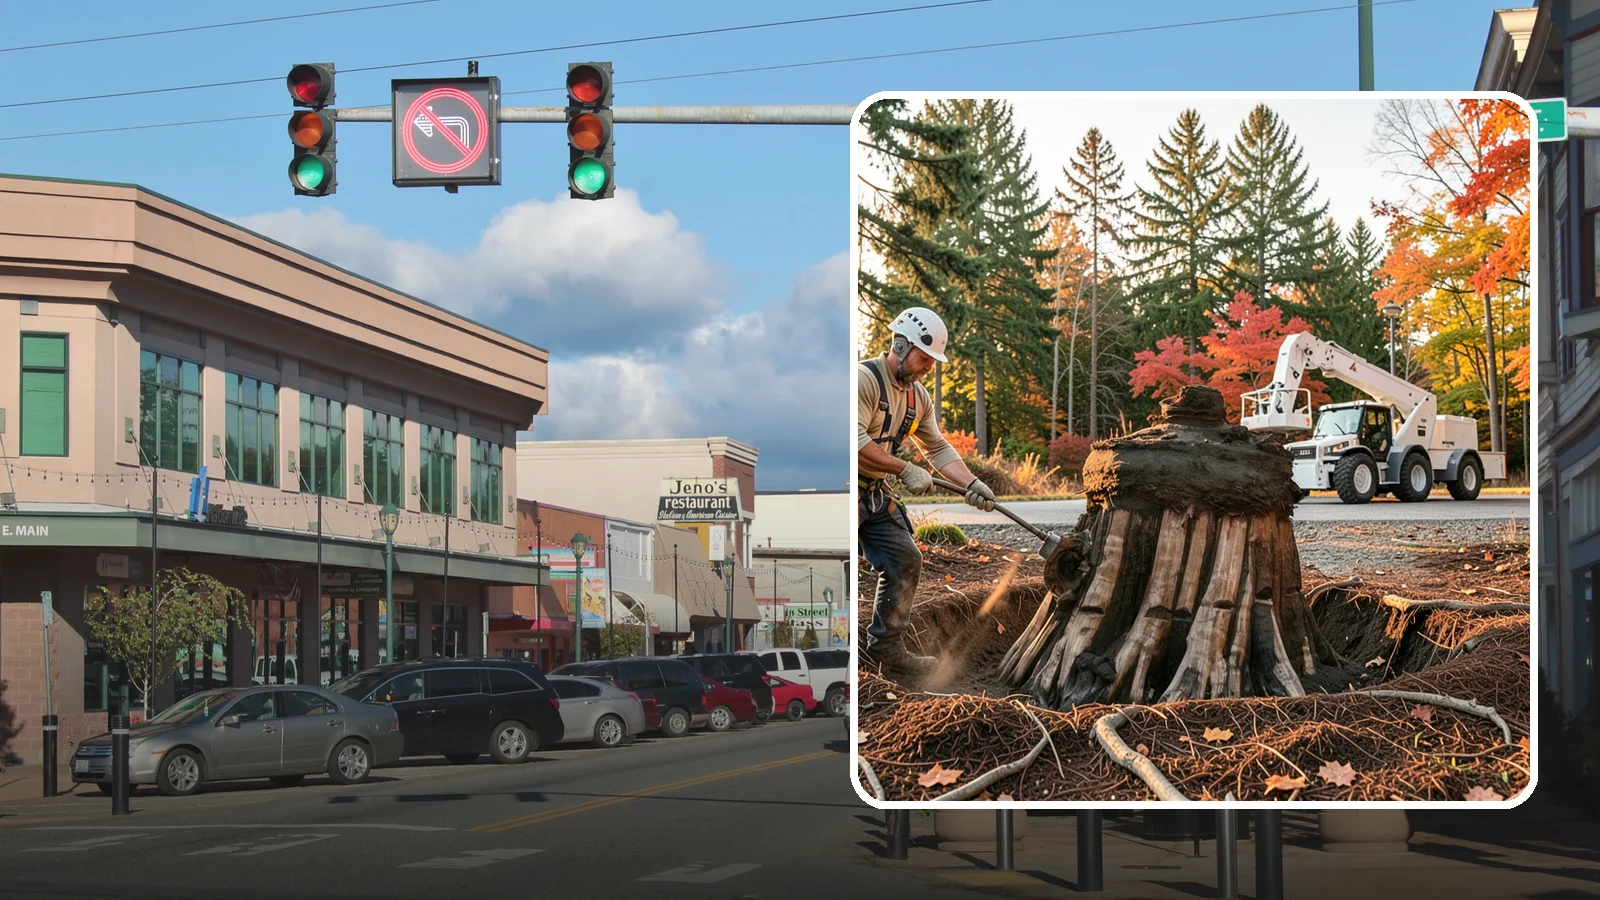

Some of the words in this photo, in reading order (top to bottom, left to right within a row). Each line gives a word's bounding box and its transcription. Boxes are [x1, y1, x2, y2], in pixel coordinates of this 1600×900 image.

[670, 480, 727, 494] Jeno's
[665, 497, 731, 509] restaurant
[658, 510, 682, 520] Italian
[686, 510, 714, 520] American
[715, 510, 737, 519] Cuisine
[2, 525, 13, 536] E.
[15, 525, 49, 536] MAIN
[797, 608, 828, 617] Street
[791, 619, 824, 627] lass
